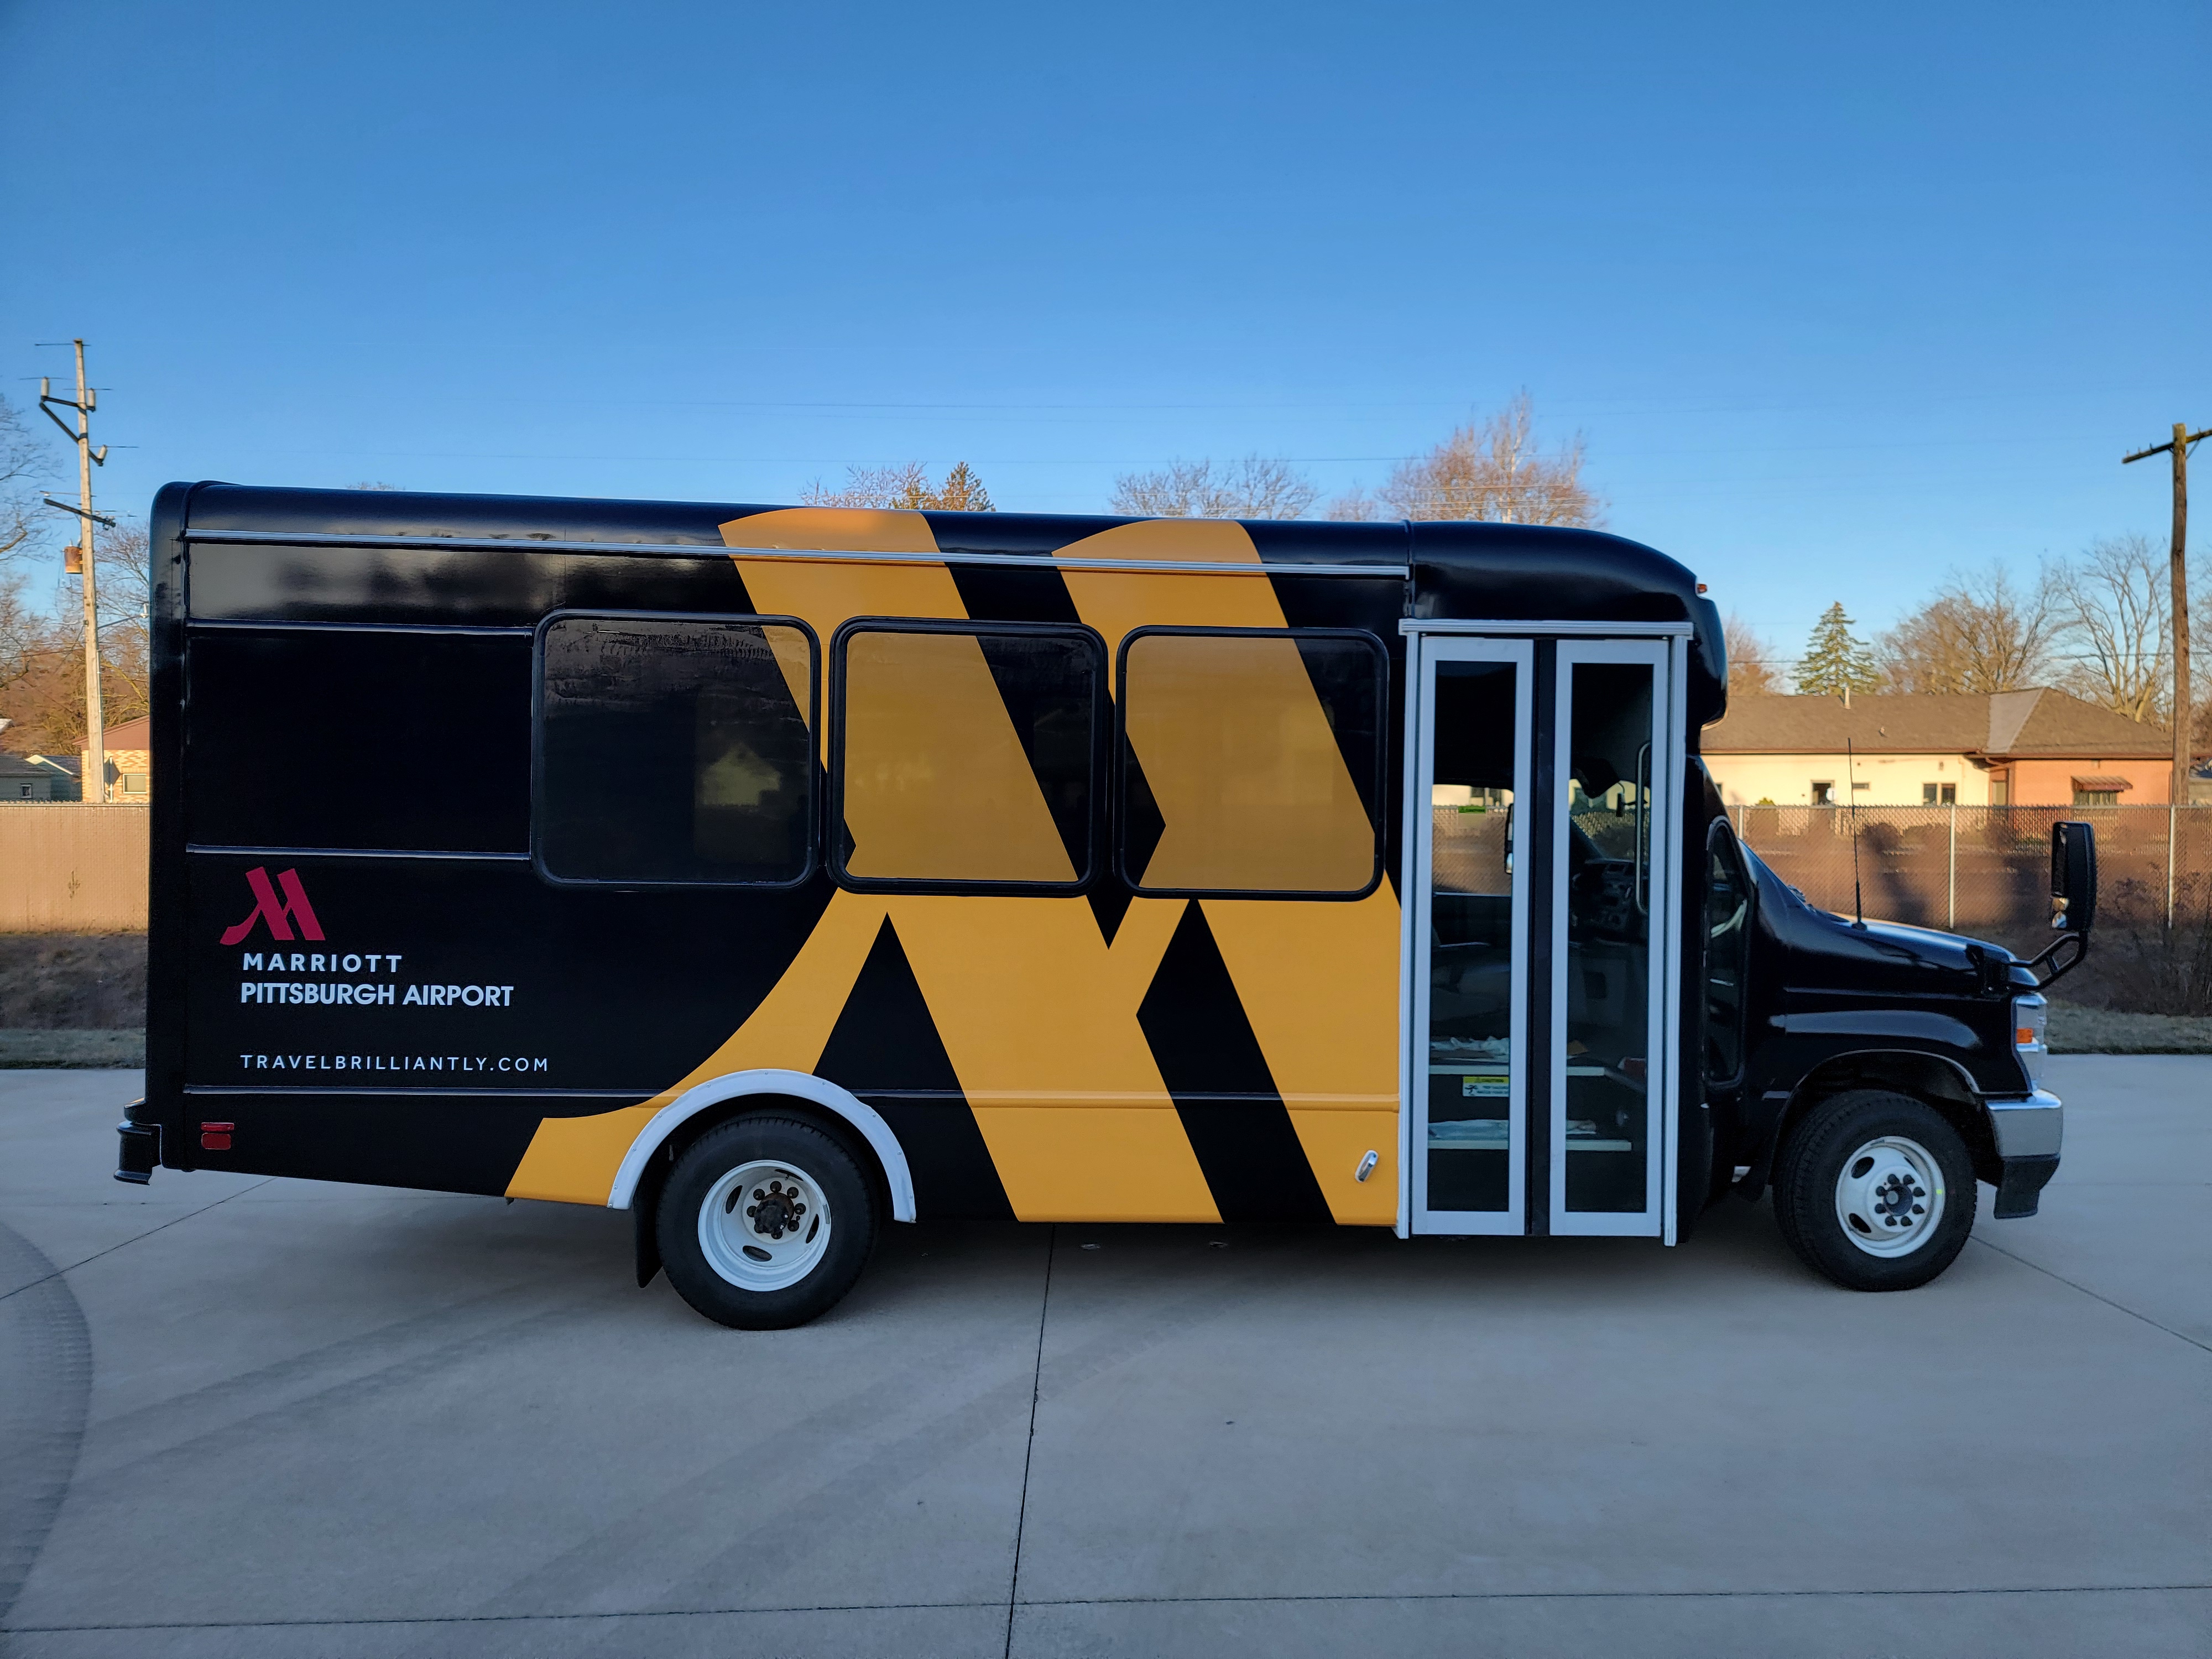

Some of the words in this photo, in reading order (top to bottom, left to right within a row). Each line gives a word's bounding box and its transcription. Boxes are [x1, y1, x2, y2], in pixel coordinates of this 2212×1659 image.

[243, 953, 402, 973] MARRIOTT
[241, 982, 394, 1005] PITTSBURGH
[403, 985, 514, 1006] AIRPORT
[239, 1055, 547, 1072] TRAVELBRILLIANTLY.COM
